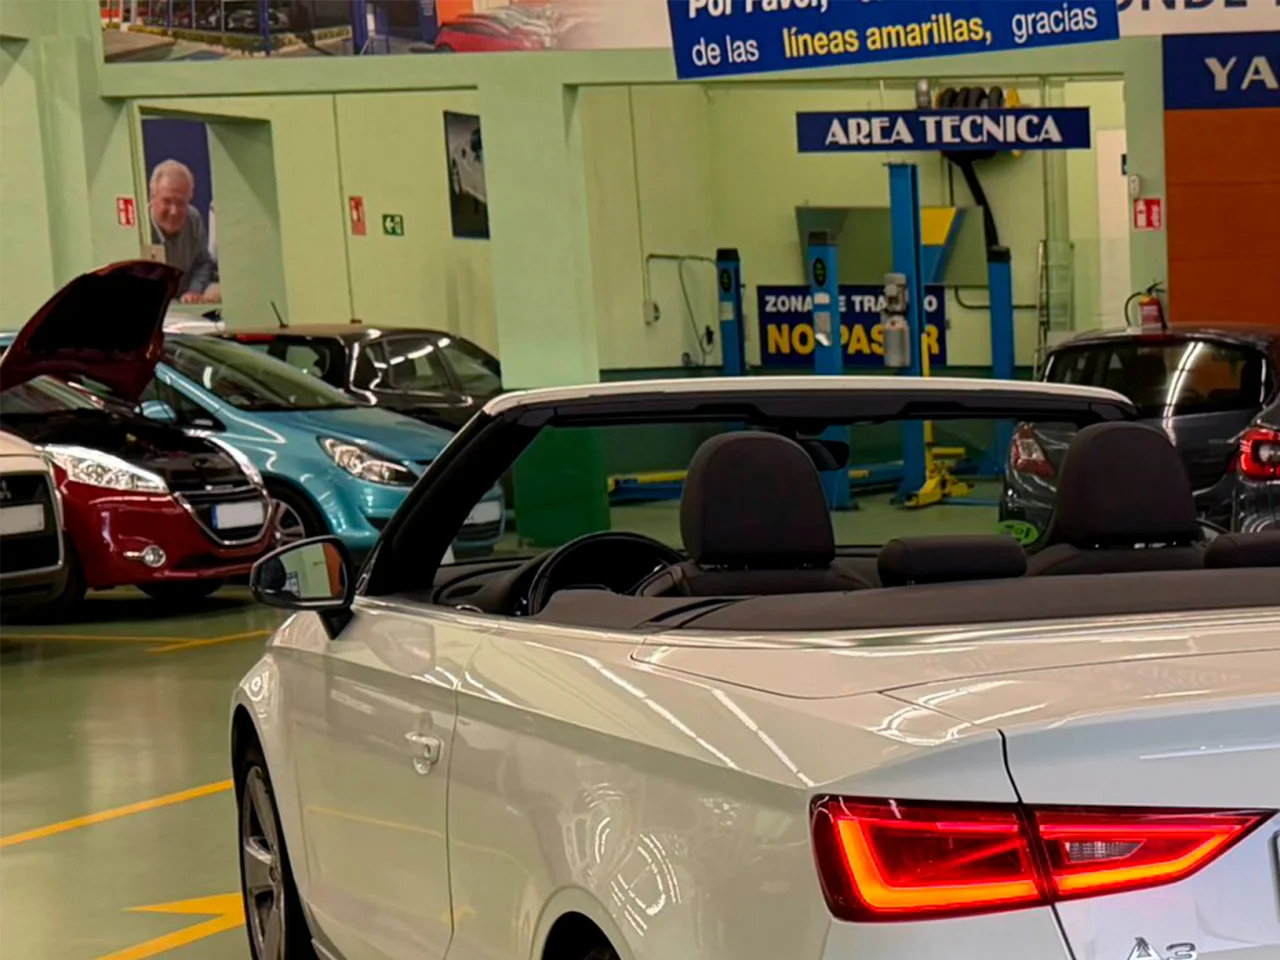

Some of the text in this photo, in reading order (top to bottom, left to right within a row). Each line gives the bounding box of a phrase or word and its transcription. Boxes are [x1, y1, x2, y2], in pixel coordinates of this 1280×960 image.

[744, 0, 828, 14] Fa,
[691, 3, 1099, 66] de las líneas amarillas, gracias
[825, 115, 1063, 146] AREA TECNICA
[765, 295, 814, 313] ZONA
[851, 295, 938, 313] TRAO
[767, 323, 940, 356] NO ASR
